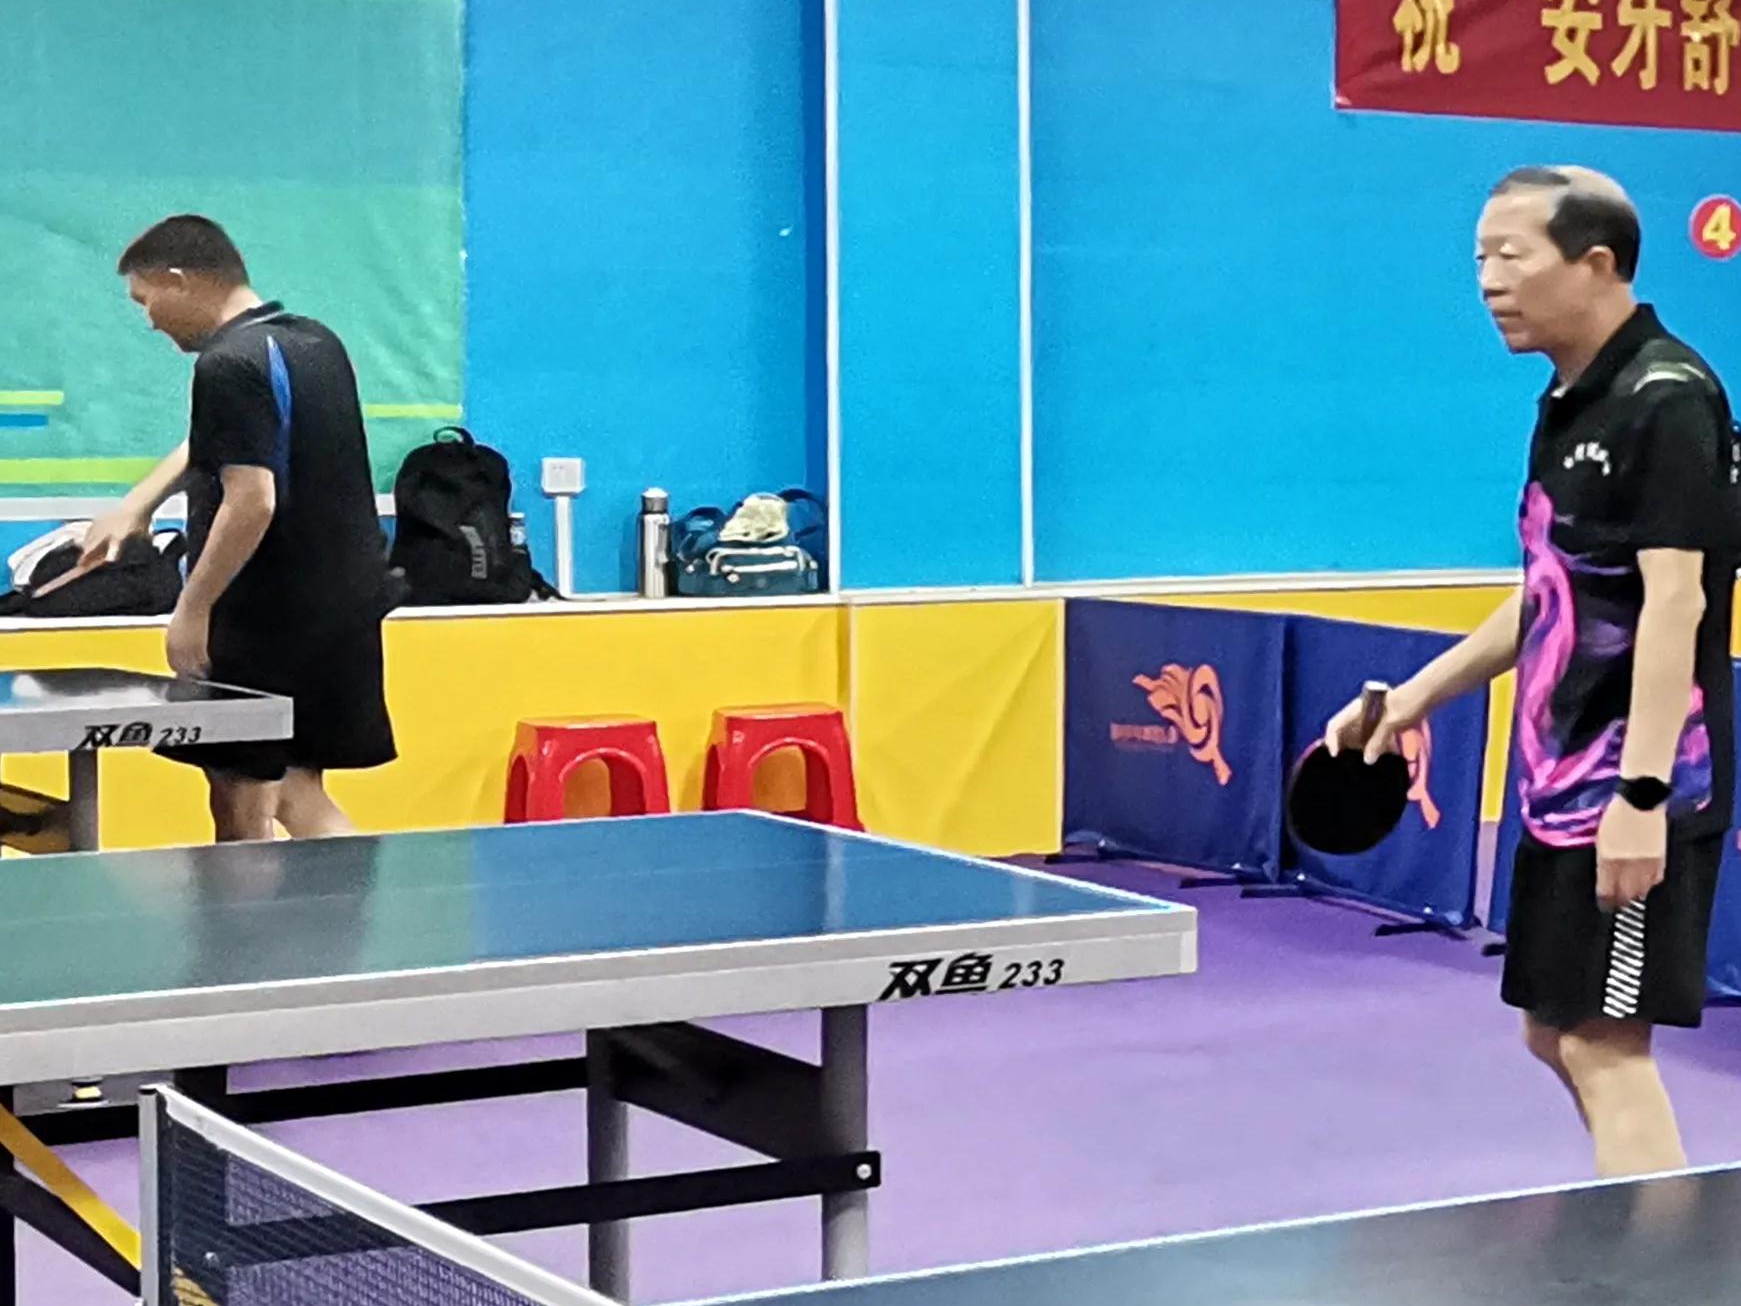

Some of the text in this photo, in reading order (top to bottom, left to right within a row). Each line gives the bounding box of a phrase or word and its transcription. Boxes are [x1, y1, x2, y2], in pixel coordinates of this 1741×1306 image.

[1702, 203, 1736, 250] 4
[159, 725, 202, 745] 233
[876, 951, 1065, 1001] 双鱼 233
